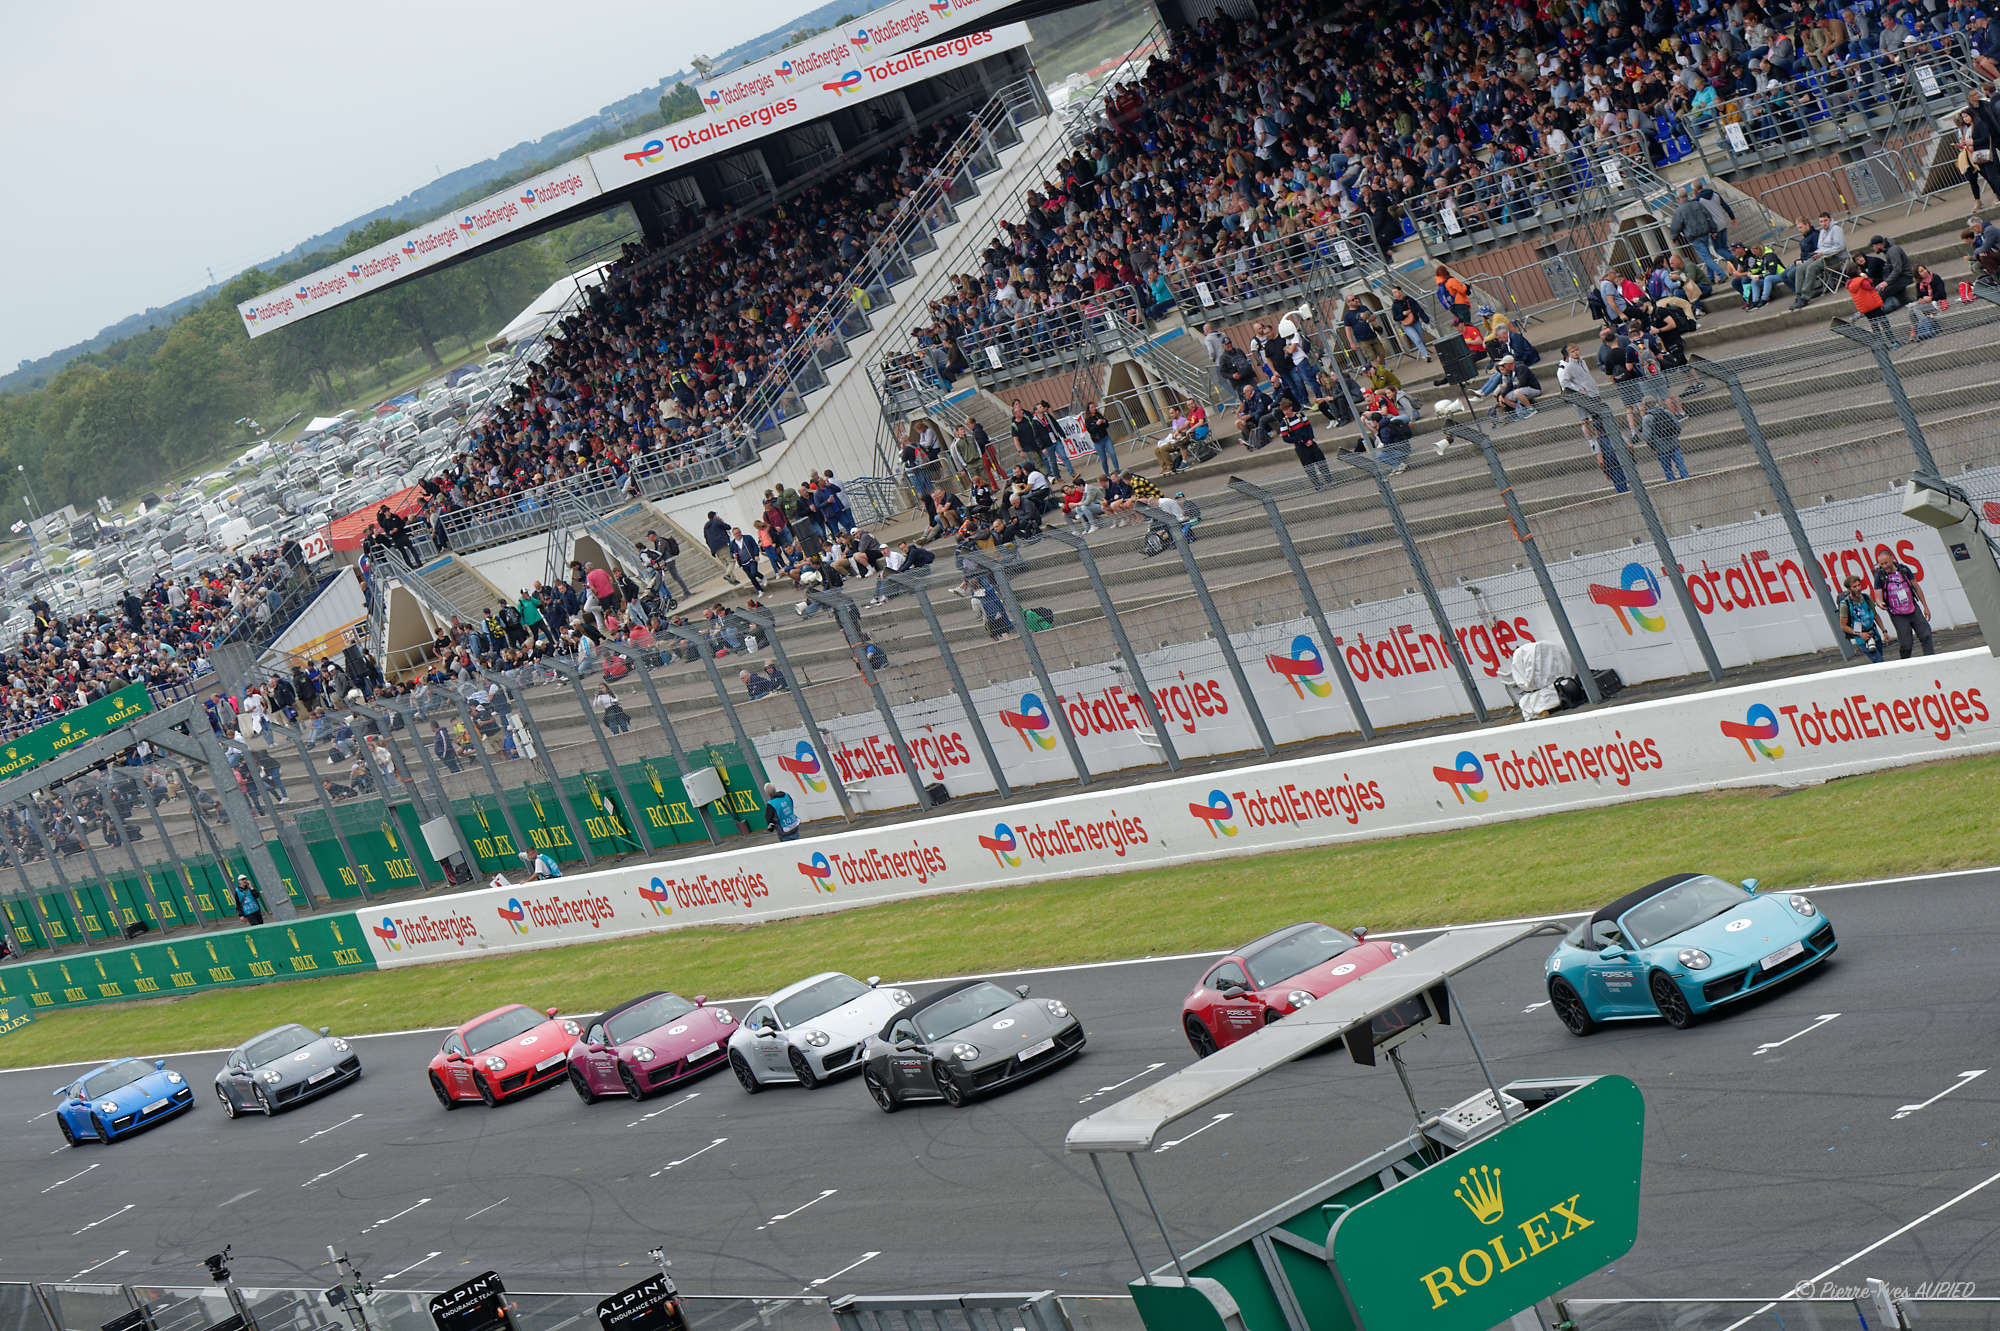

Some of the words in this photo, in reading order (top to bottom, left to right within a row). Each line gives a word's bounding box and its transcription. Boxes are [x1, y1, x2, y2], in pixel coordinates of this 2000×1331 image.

[868, 9, 930, 45] TotalEnergies
[791, 42, 851, 77] TotalEnergies
[719, 73, 774, 106] TotalEnergies
[534, 172, 584, 205] TotalEnergies
[472, 201, 519, 230] TotalEnergies
[412, 226, 459, 257] TotalEnergies
[358, 251, 401, 281] TotalEnergies
[306, 274, 347, 303] TotalEnergies
[304, 538, 326, 558] 22
[107, 703, 142, 724] ROLEX
[1779, 679, 1989, 741] TotalEnergies
[53, 728, 89, 750] ROLEX
[0, 753, 35, 775] ROLEX
[1484, 730, 1663, 787] TotalEnergies
[1233, 773, 1385, 825] TotalEnergies
[1015, 810, 1149, 857] TotalEnergies
[385, 859, 416, 880] ROLE
[830, 840, 946, 884] TotalEnergies
[666, 867, 769, 909] TotalEnergies
[522, 891, 614, 928] TotalEnergies
[395, 911, 477, 946] TotalEnergies
[209, 966, 236, 982] ROLEX
[249, 960, 276, 977] ROLEX
[291, 954, 319, 972] ROLEX
[135, 977, 160, 993] ROLEX
[171, 971, 197, 988] ROLEX
[0, 1013, 31, 1035] OLEX
[1420, 1192, 1595, 1309] ROLEX
[442, 1297, 478, 1319] ENDURANCE
[611, 1302, 650, 1324] ENDURANCE
